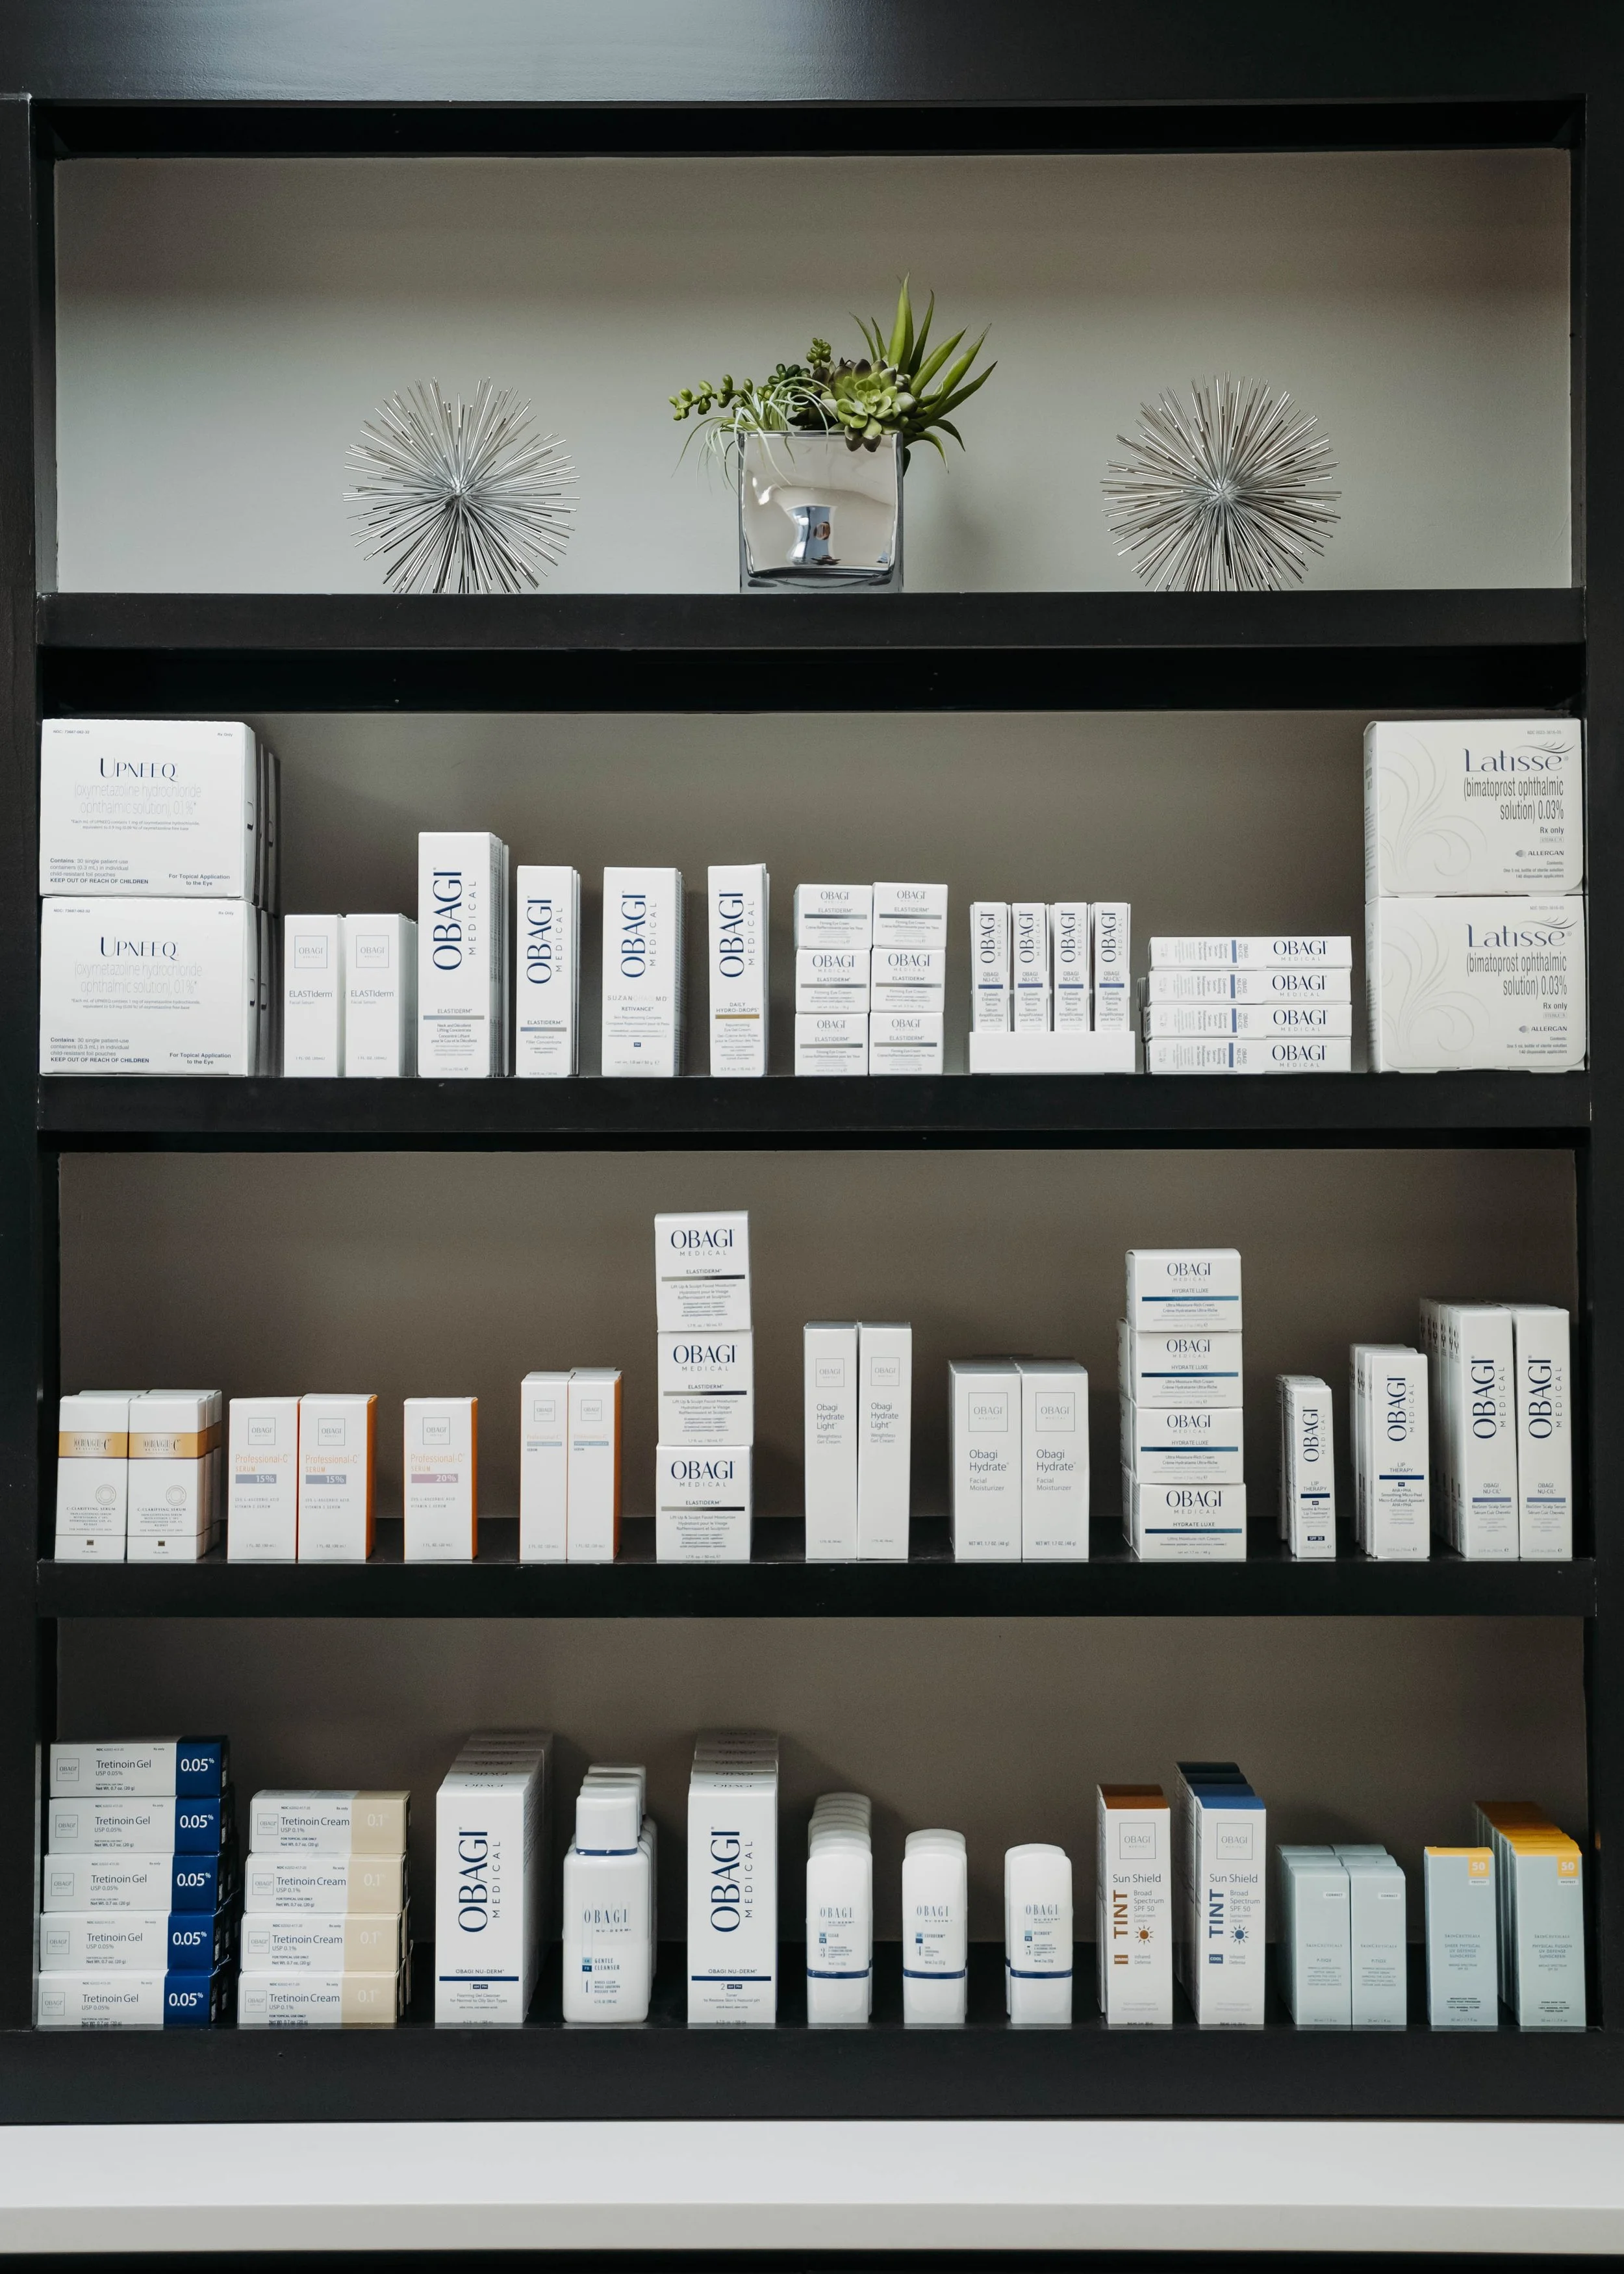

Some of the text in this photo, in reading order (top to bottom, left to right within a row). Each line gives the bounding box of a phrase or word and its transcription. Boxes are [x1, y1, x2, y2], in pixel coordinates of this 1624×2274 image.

[1465, 748, 1562, 772] Latisse
[100, 758, 175, 782] UPNEEQ
[1464, 776, 1564, 801] (bimatoprost ophthalmic
[1501, 800, 1564, 824] solution) 0.03%
[1551, 826, 1564, 835] only
[820, 891, 849, 900] OBAGI
[897, 891, 926, 899] OBAGI
[433, 872, 462, 970] OBAGI
[621, 895, 646, 978] OBAGI
[719, 893, 744, 977] OBAGI
[980, 914, 995, 964] OBAGI
[1019, 913, 1034, 963] OBAGI
[1061, 913, 1075, 962] OBAGI
[1102, 913, 1116, 962] OBAGI
[1467, 923, 1565, 947] Latisse
[101, 937, 176, 960] UPNEEQ
[527, 900, 552, 984] OBAGI
[1273, 941, 1326, 954] OBAGI
[813, 955, 854, 967] OBAGI
[888, 954, 930, 966] OBAGI
[1467, 951, 1567, 976] (bimatoprost ophthalmic
[1273, 975, 1325, 990] OBAGI
[1503, 975, 1567, 999] solution) 0.03%
[817, 1020, 845, 1028] OBAGI
[892, 1019, 920, 1028] OBAGI
[1273, 1010, 1325, 1025] OBAGI
[1272, 1045, 1325, 1060] OBAGI
[671, 1229, 732, 1248] OBAGI
[1167, 1263, 1210, 1275] OBAGI
[1167, 1340, 1210, 1352] OBAGI
[673, 1345, 735, 1363] OBAGI
[1471, 1360, 1496, 1438] OBAGI
[1528, 1360, 1552, 1438] OBAGI
[817, 1403, 837, 1412] Obagi
[871, 1402, 892, 1411] Obagi
[1387, 1378, 1406, 1441] OBAGI
[817, 1413, 844, 1422] Hydrate
[1167, 1415, 1210, 1427] OBAGI
[817, 1422, 835, 1431] Light
[871, 1421, 889, 1430] Light
[1302, 1409, 1319, 1462] OBAGI
[235, 1453, 288, 1464] Professional-C
[306, 1454, 357, 1464] Professional-C
[969, 1450, 998, 1461] Obagi
[1036, 1449, 1065, 1461] Obagi
[671, 1461, 733, 1479] OBAGI
[970, 1462, 1006, 1474] Hydrate
[1037, 1462, 1073, 1473] Hydrate
[1166, 1490, 1221, 1507] OBAGI
[96, 1759, 151, 1769] Tretinoin Gel
[181, 1758, 214, 1772] 0.05%
[95, 1816, 150, 1825] Tretinoin Gel
[180, 1815, 214, 1828] 0.05%
[281, 1817, 349, 1826] Tretinoin Cream
[1472, 1862, 1486, 1871] 50
[1562, 1861, 1575, 1871] 50
[132, 1874, 147, 1883] Gel
[177, 1872, 211, 1886] 0.05%
[277, 1877, 346, 1885] Tretinoin Cream
[458, 1832, 488, 1932] OBAGI
[711, 1832, 740, 1932] OBAGI
[744, 1841, 753, 1918] MEDICAL
[1113, 1874, 1161, 1883] Sun Shield
[1210, 1874, 1258, 1883] Sun Shield
[584, 1909, 626, 1923] OBAGI
[820, 1908, 852, 1918] OBAGI
[917, 1906, 948, 1917] OBAGI
[1026, 1904, 1058, 1915] OBAGI
[1113, 1890, 1128, 1939] TINT
[1209, 1889, 1224, 1938] TINT
[128, 1933, 142, 1941] Gel
[173, 1932, 207, 1945] 0.05%
[272, 1935, 342, 1943] Tretinoin Cream
[82, 1994, 138, 2002] Tretinoin Gel
[169, 1993, 203, 2006] 0.05%
